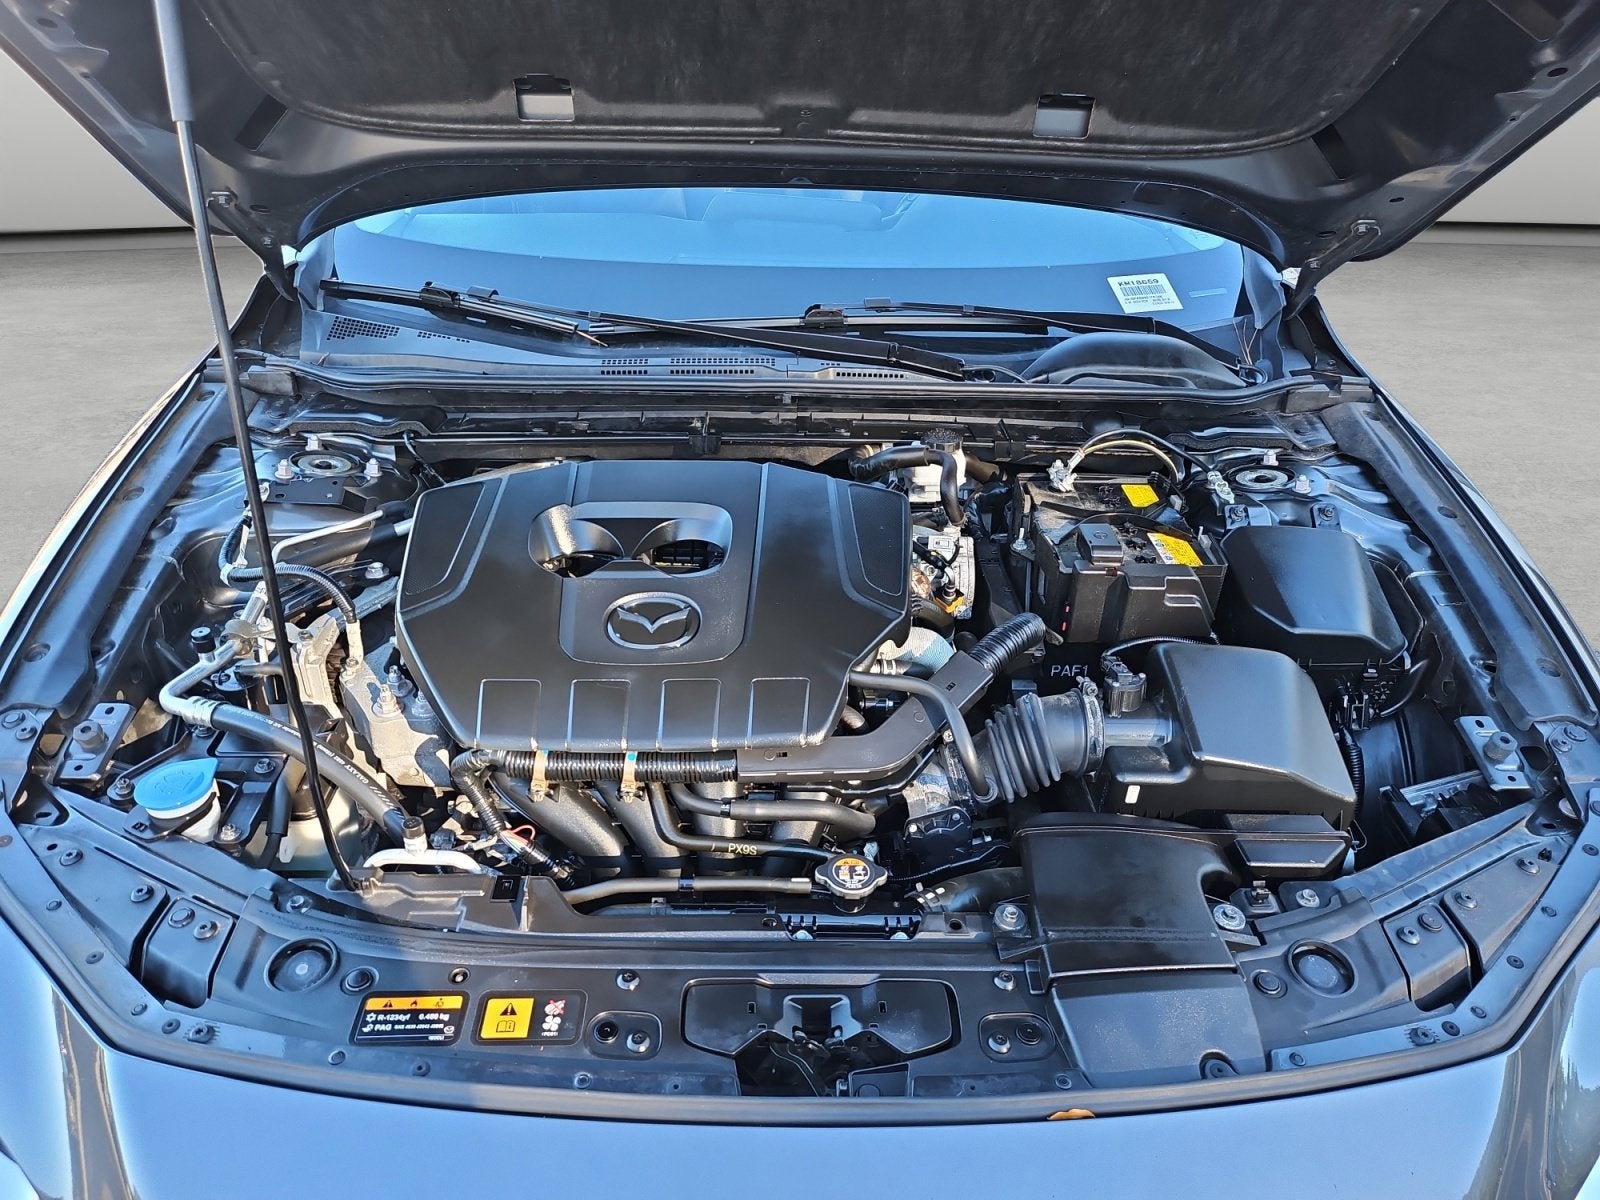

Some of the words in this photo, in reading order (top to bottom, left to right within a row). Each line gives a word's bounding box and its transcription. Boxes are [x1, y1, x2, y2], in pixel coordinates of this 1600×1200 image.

[1050, 664, 1089, 677] PAF1
[344, 764, 369, 784] GALAXY
[728, 842, 758, 856] PX9S
[377, 1013, 411, 1022] R-1234yf
[439, 1012, 450, 1021] kg
[374, 1023, 392, 1031] PAG
